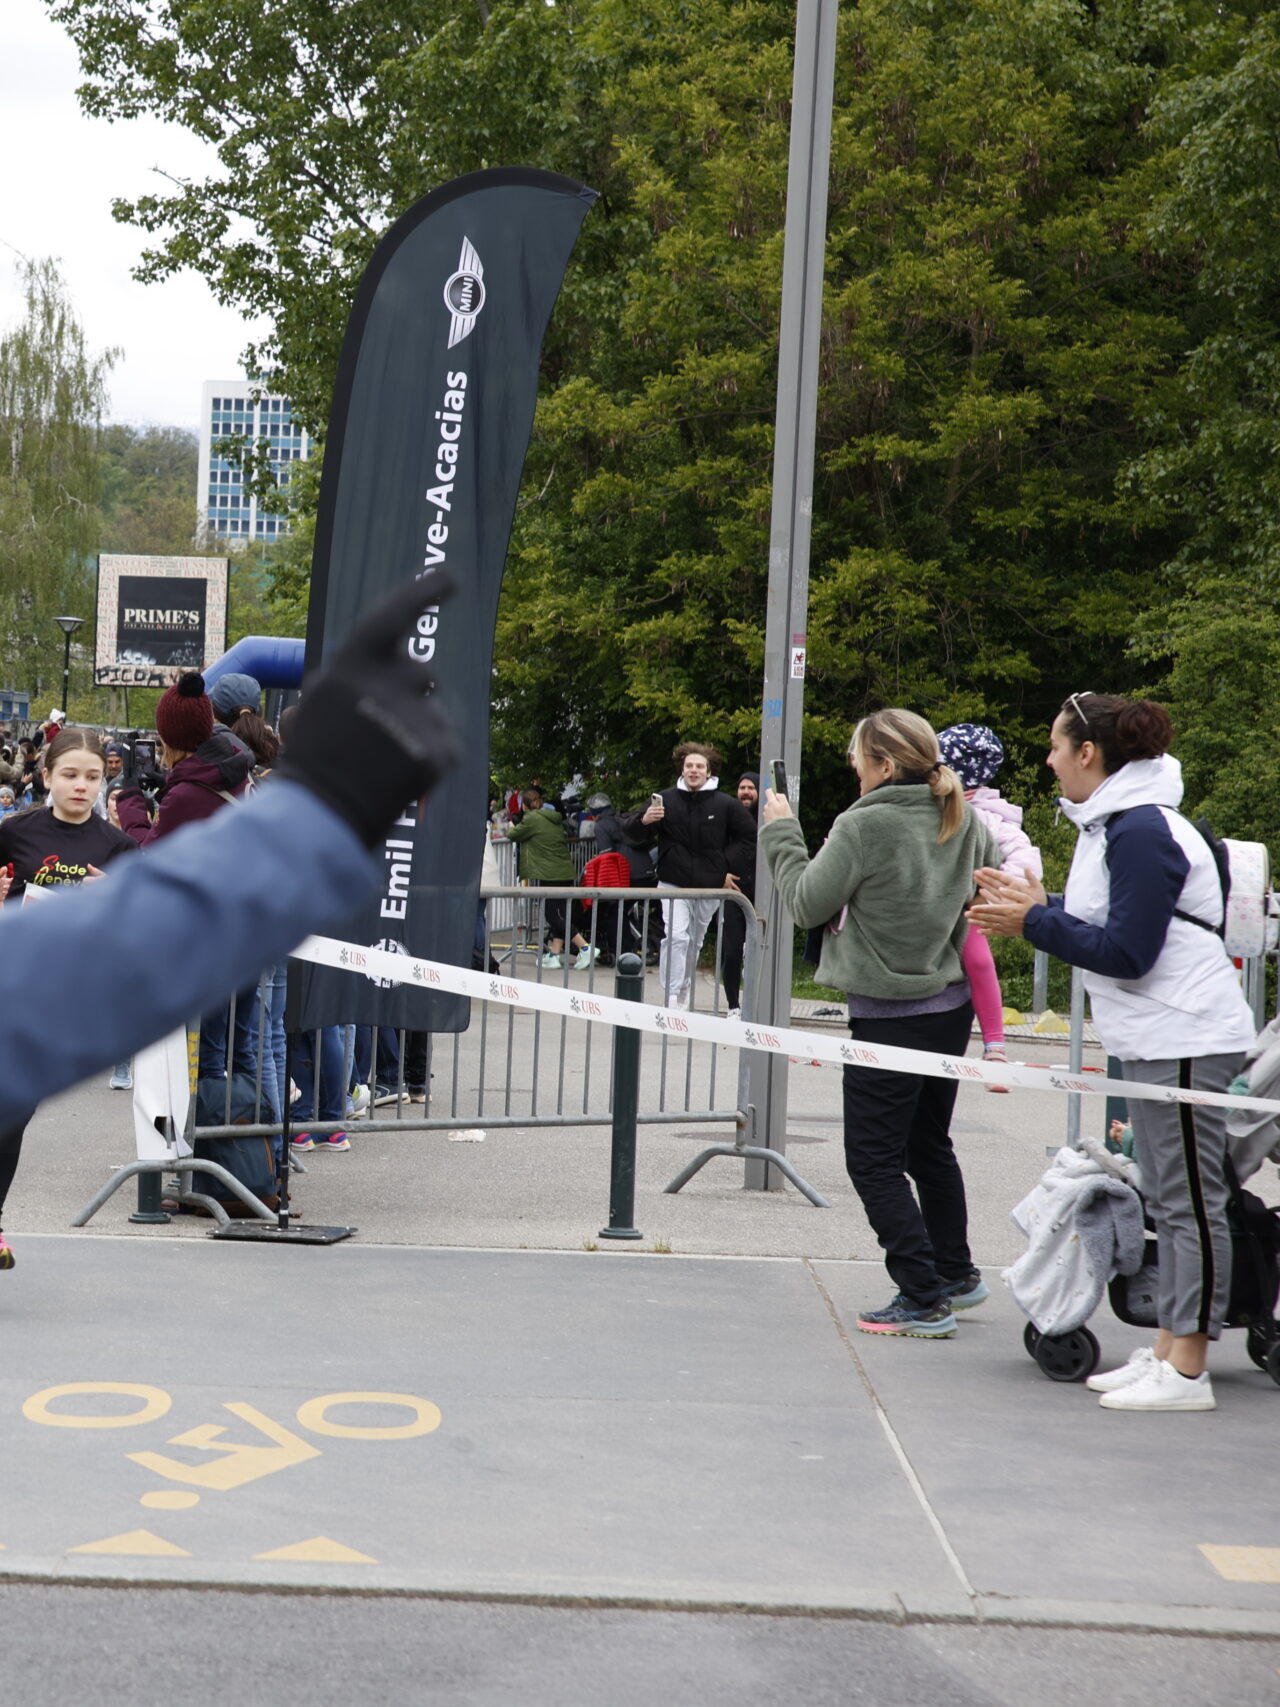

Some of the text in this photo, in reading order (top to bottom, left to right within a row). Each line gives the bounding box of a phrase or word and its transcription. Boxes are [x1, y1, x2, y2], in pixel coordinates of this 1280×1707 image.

[460, 276, 473, 311] MINI
[124, 608, 200, 625] PRIME'S
[380, 839, 413, 919] Emil
[408, 371, 467, 663] Geve-Acacias
[35, 855, 87, 876] Stade
[349, 952, 366, 967] UBS
[422, 968, 440, 983] UBS
[500, 984, 519, 999] UBS
[581, 1001, 601, 1016] UBS
[667, 1016, 688, 1032] UBS
[756, 1032, 781, 1048] UBS
[853, 1048, 879, 1064] UBS
[955, 1064, 983, 1079] UBS
